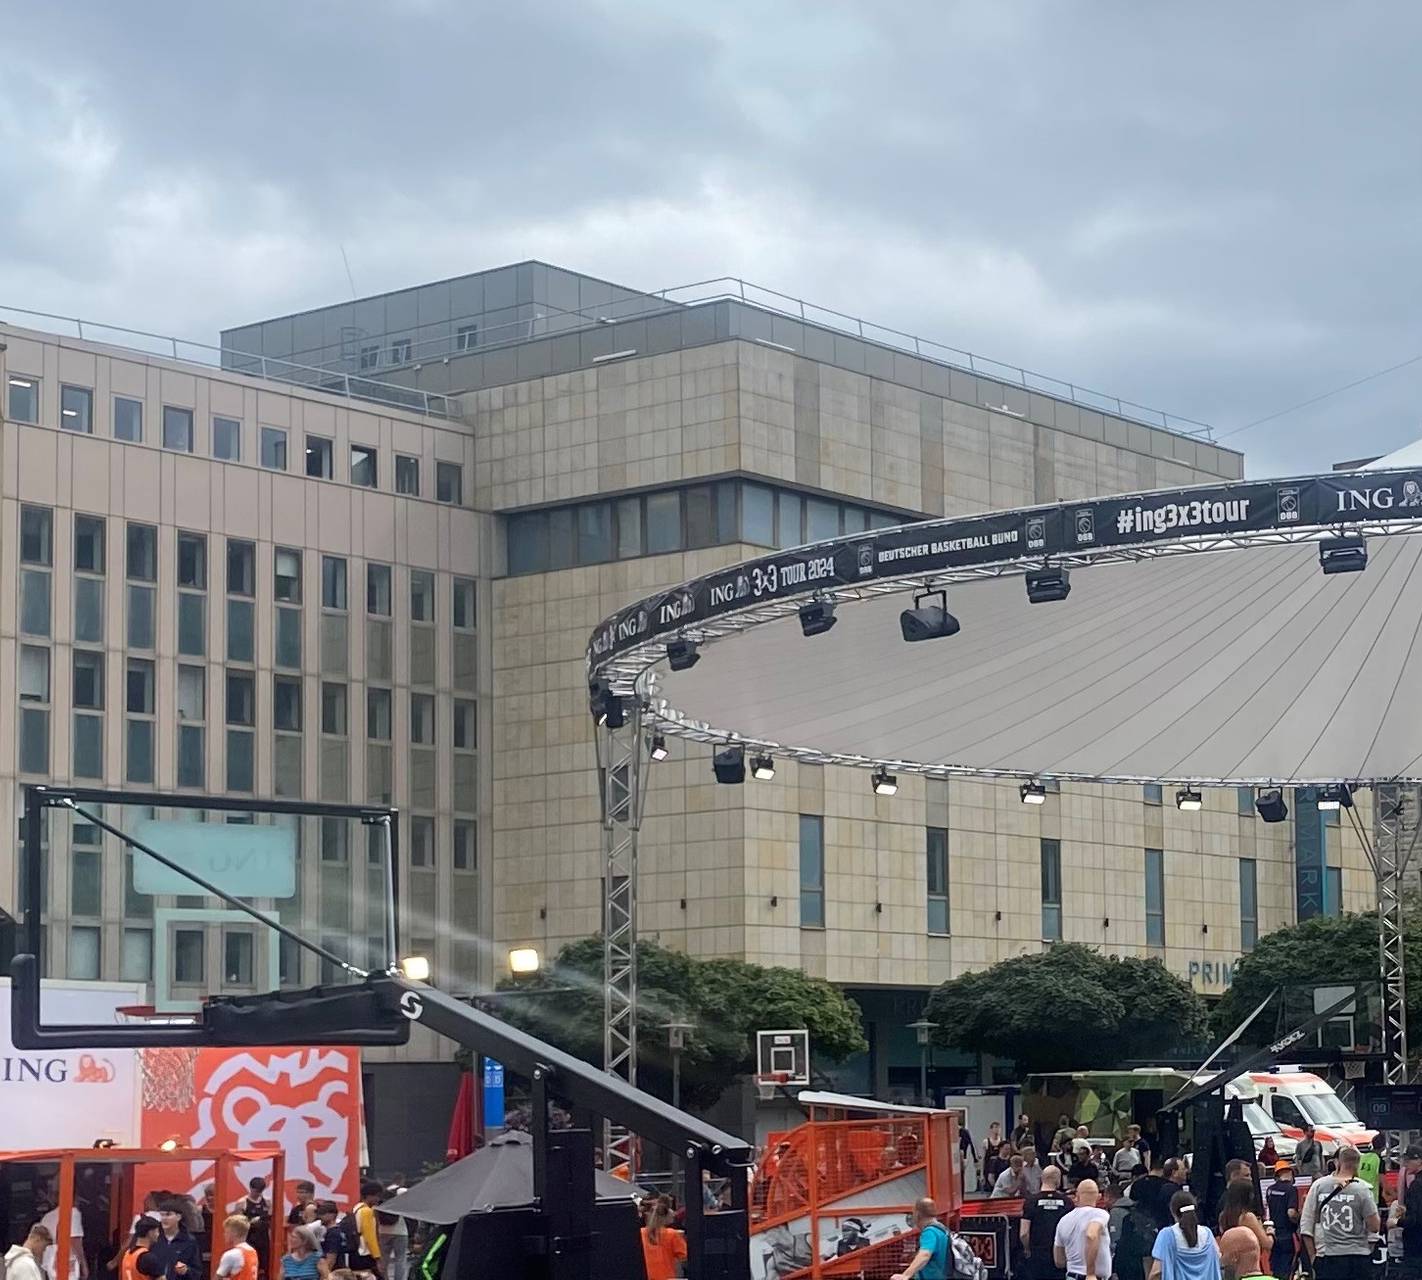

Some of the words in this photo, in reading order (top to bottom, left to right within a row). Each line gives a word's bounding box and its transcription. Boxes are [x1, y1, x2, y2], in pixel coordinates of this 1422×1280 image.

[1336, 487, 1394, 512] ING
[1116, 500, 1249, 534] #ing3x3tour
[878, 540, 929, 563] DEUTSCHER
[931, 534, 990, 553] BASKETBALL
[991, 530, 1018, 544] BUND
[710, 582, 734, 606] ING
[781, 563, 806, 587] TOUR
[808, 557, 835, 579] 2024
[660, 600, 684, 624] ING
[618, 618, 636, 640] ING
[3, 1057, 67, 1083] ING
